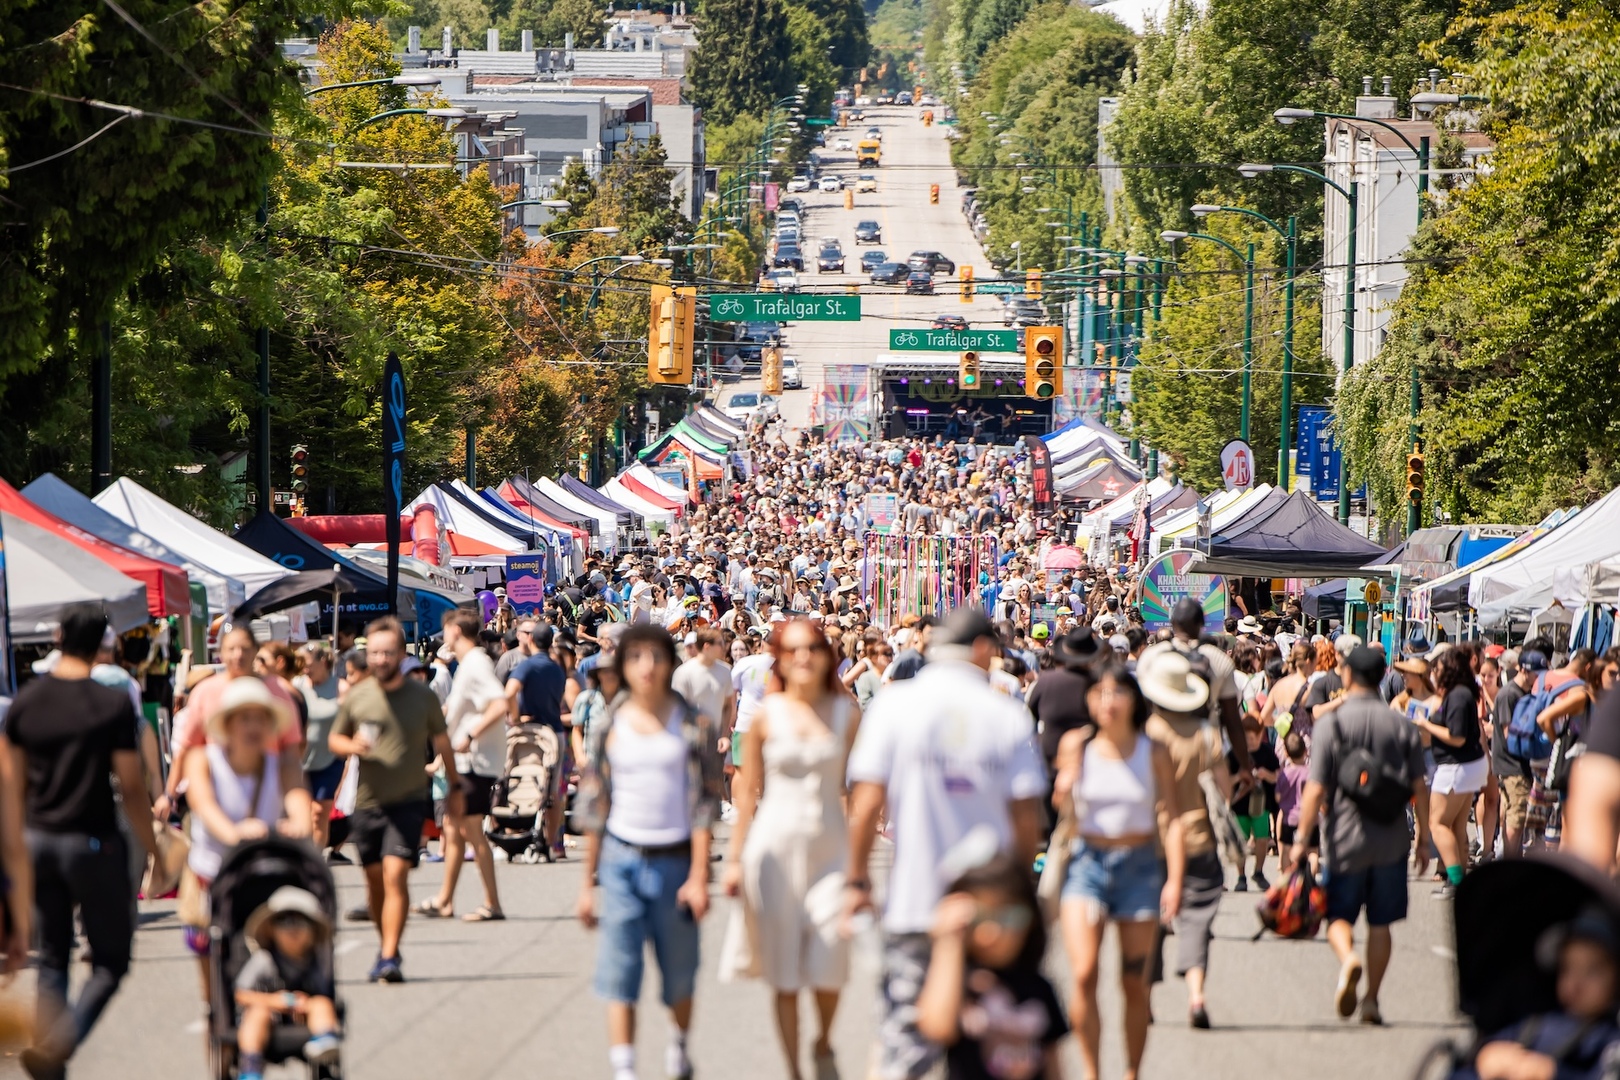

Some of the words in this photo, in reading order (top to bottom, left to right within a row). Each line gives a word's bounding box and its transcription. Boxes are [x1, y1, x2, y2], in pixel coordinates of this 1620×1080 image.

[754, 299, 820, 318] Trafalgar
[825, 299, 847, 315] St.
[926, 333, 983, 350] Trafalgar
[987, 333, 1005, 347] St.
[827, 408, 867, 420] STAGE
[511, 561, 538, 573] steamoji
[1158, 575, 1210, 585] KHATSAHLAND
[1162, 595, 1205, 607] KHS
[1369, 590, 1378, 600] 10
[323, 603, 344, 613] Jon
[346, 604, 357, 612] at
[358, 602, 389, 612] evo.ca
[420, 596, 432, 631] evo
